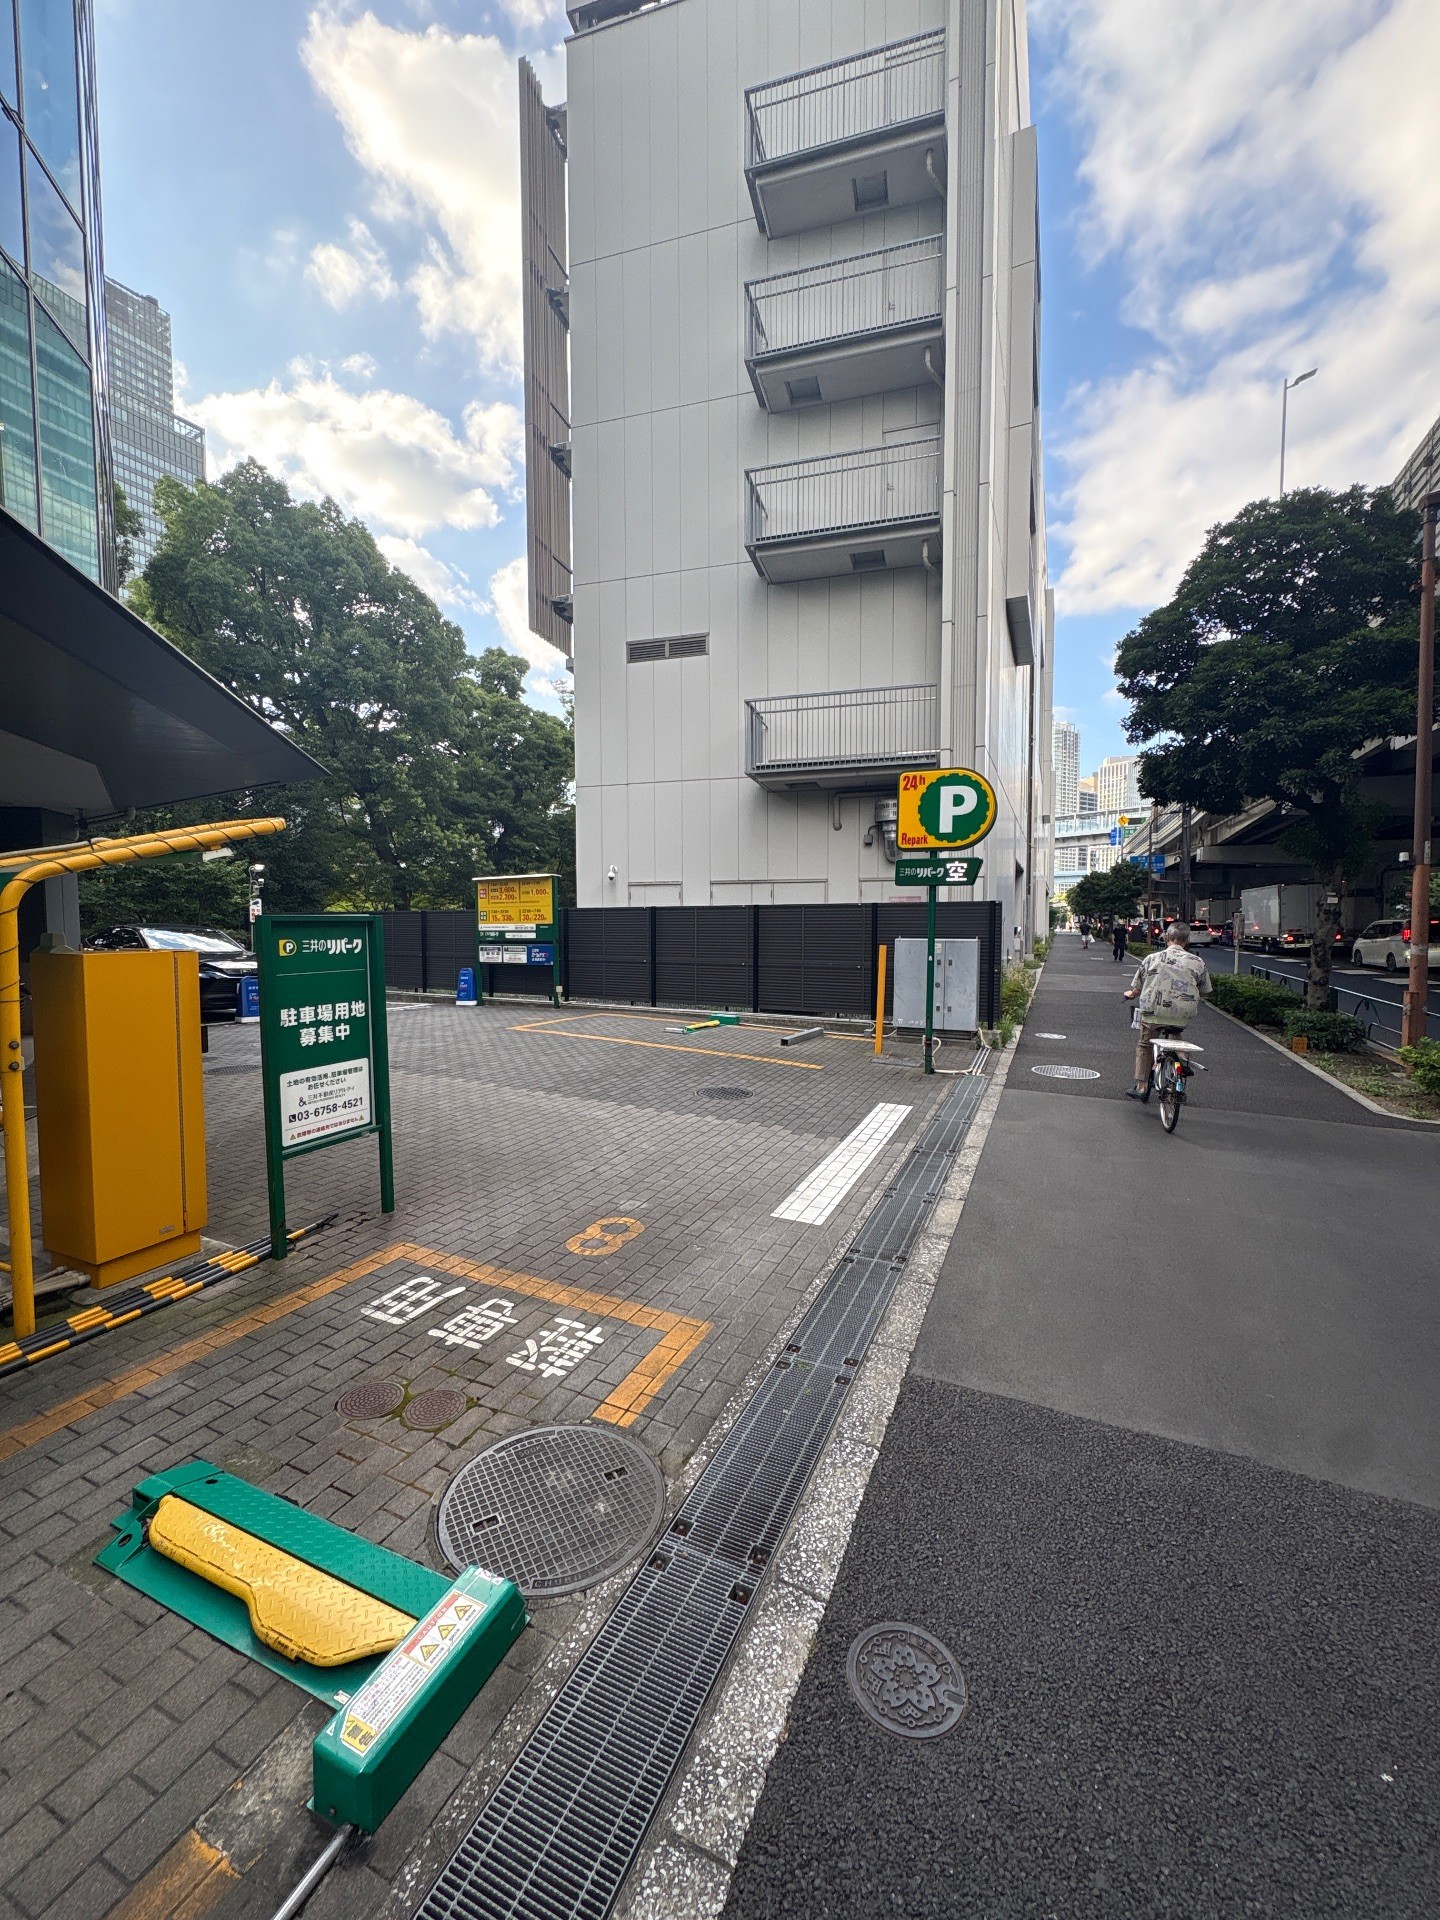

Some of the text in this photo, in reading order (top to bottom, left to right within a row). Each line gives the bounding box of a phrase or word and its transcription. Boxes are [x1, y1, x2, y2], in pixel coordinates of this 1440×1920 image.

[902, 775, 926, 791] 24h
[939, 785, 978, 834] P
[901, 833, 928, 846] Repark
[899, 867, 944, 878] 三井のリパーク
[945, 861, 968, 882] 空
[302, 937, 362, 954] 三井のリパーク
[280, 1000, 366, 1027] 駐車場用地
[299, 1023, 350, 1047] 募集中
[297, 1096, 363, 1121] 03-6758-4521
[566, 1216, 645, 1256] 8
[417, 1607, 449, 1640] CAUTION
